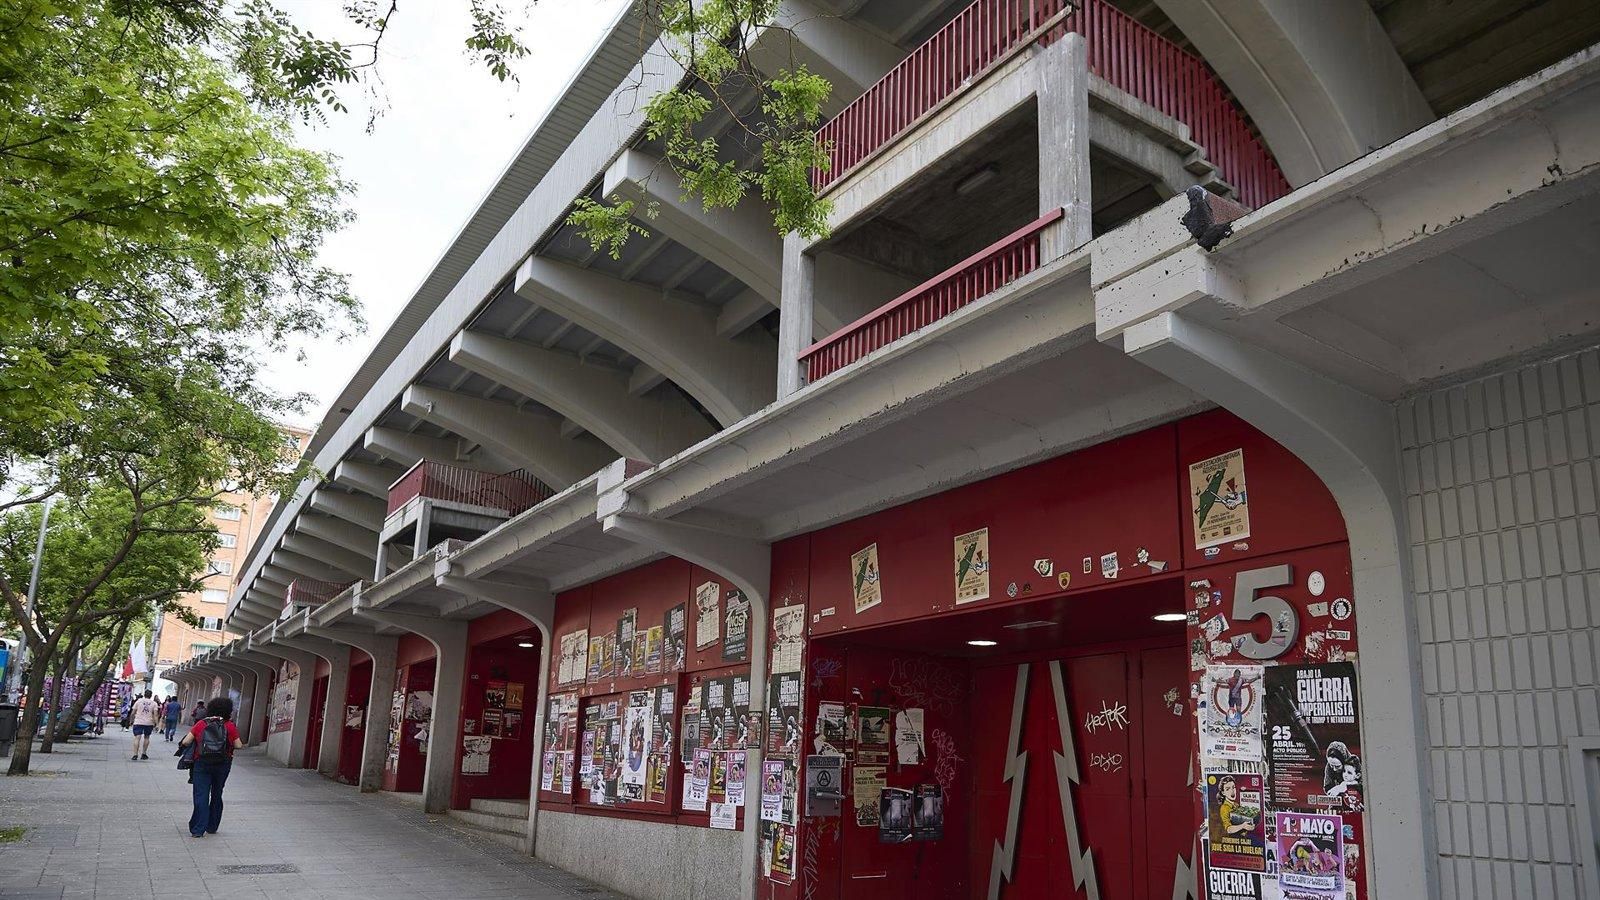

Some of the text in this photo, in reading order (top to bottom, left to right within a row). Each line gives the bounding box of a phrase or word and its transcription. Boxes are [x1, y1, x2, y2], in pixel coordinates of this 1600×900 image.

[1232, 564, 1298, 659] 5
[1297, 669, 1321, 679] ABAJO LA
[1297, 677, 1352, 702] GUERRA
[1298, 702, 1354, 716] IMPERIALISTA
[1272, 725, 1291, 740] 25
[1301, 818, 1335, 834] MAYO
[1223, 844, 1234, 852] SIGA
[1243, 846, 1263, 855] HUELGA!
[1210, 871, 1255, 895] GUERRA
